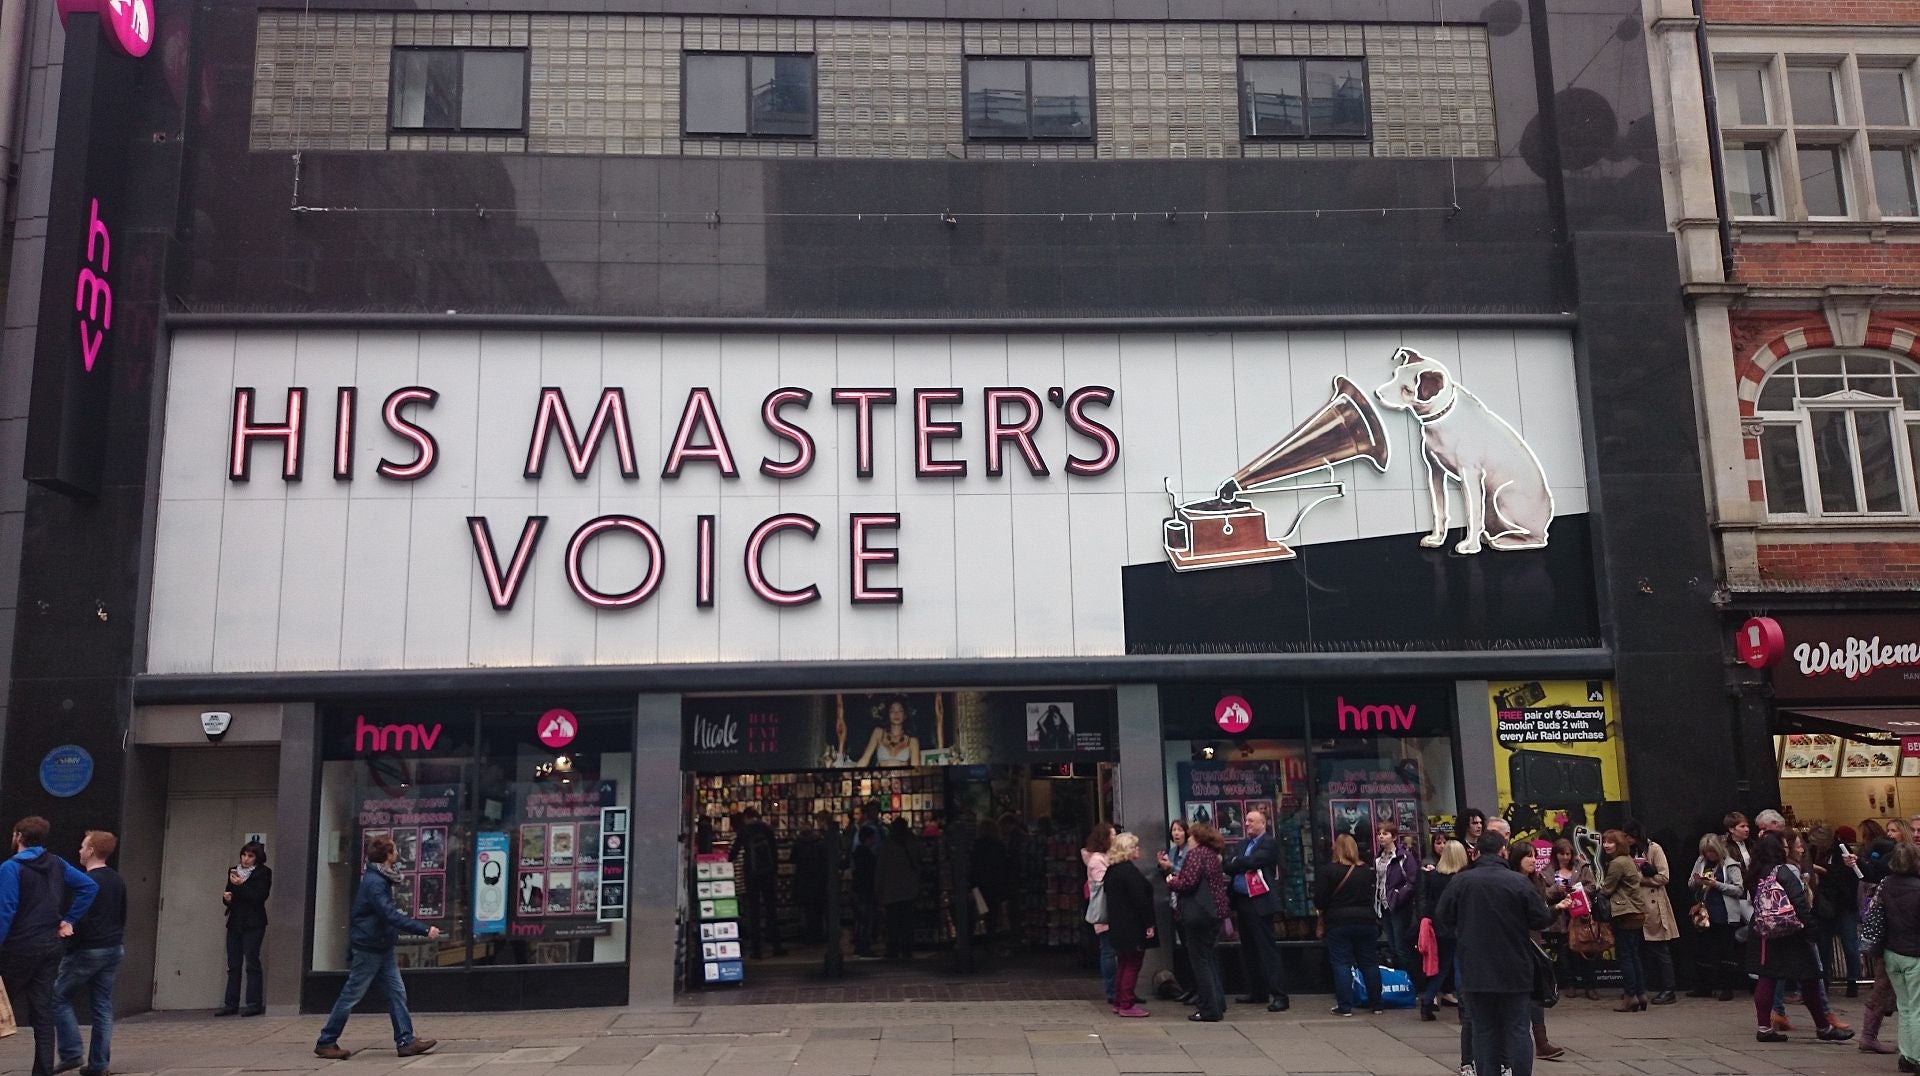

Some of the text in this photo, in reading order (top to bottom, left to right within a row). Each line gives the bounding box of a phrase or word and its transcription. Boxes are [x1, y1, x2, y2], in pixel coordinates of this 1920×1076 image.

[76, 197, 112, 372] hmv
[229, 386, 1120, 482] HIS MASTER'S
[466, 512, 904, 611] VOICE
[1793, 635, 1920, 679] Wafflem
[1337, 696, 1416, 731] hmv
[1498, 711, 1603, 721] FREE pair of Skullcandy
[1500, 721, 1589, 731] Smokin' Buds 2 with
[355, 714, 442, 752] hmv
[693, 714, 738, 749] Nicole
[1500, 731, 1604, 742] every Air Raid purchase
[1328, 781, 1416, 794] DVD releases
[359, 812, 390, 825] DVD
[526, 806, 544, 818] TV
[511, 922, 545, 937] hmv
